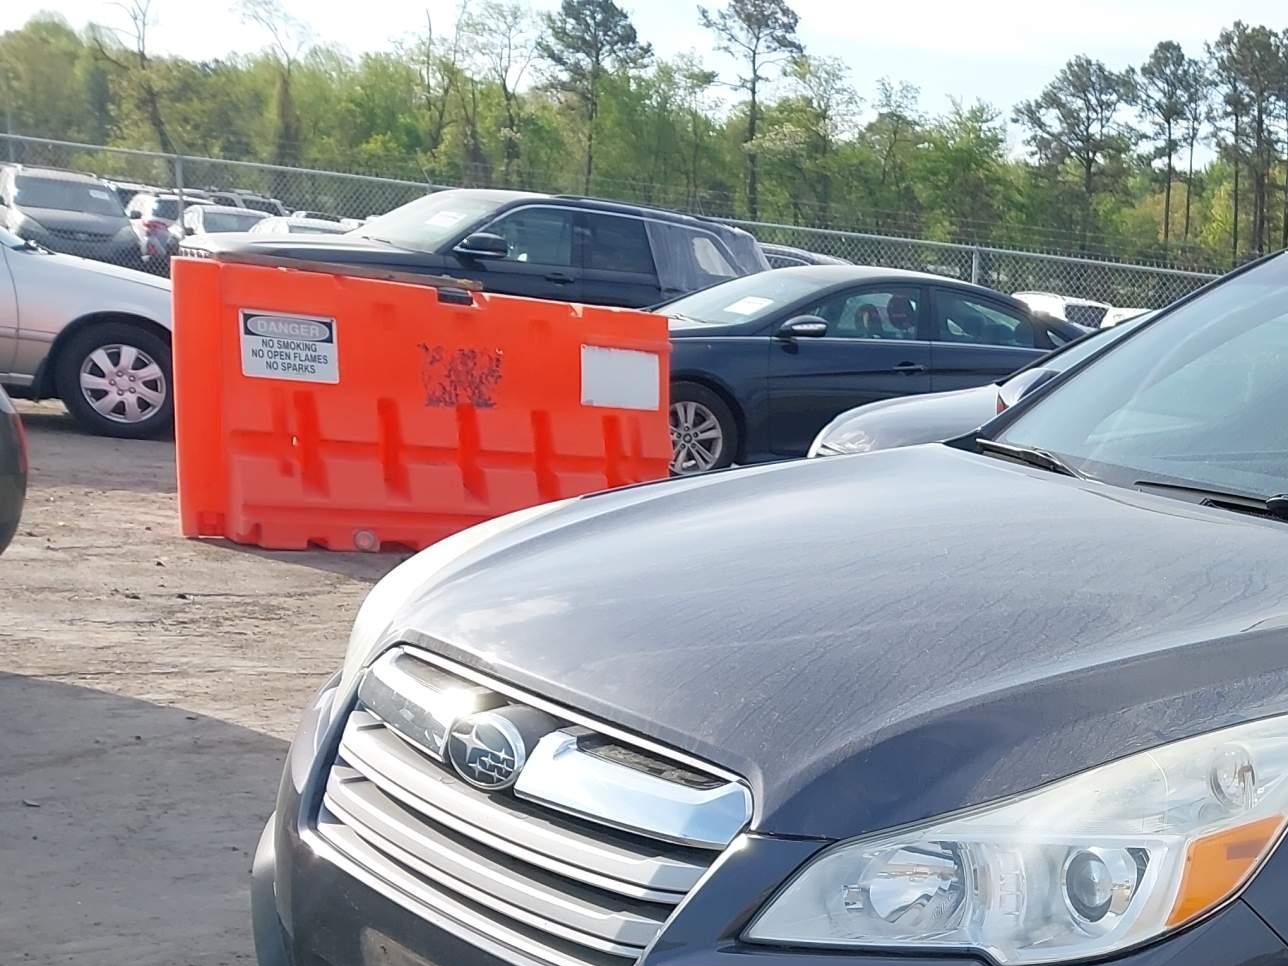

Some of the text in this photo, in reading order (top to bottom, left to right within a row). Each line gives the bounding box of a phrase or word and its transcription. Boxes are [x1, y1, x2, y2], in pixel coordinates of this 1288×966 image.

[257, 320, 320, 337] DANGER
[261, 338, 317, 353] NO SMOKING
[251, 348, 328, 365] NO OPEN FLAMES
[265, 360, 316, 374] NO SPARKS
